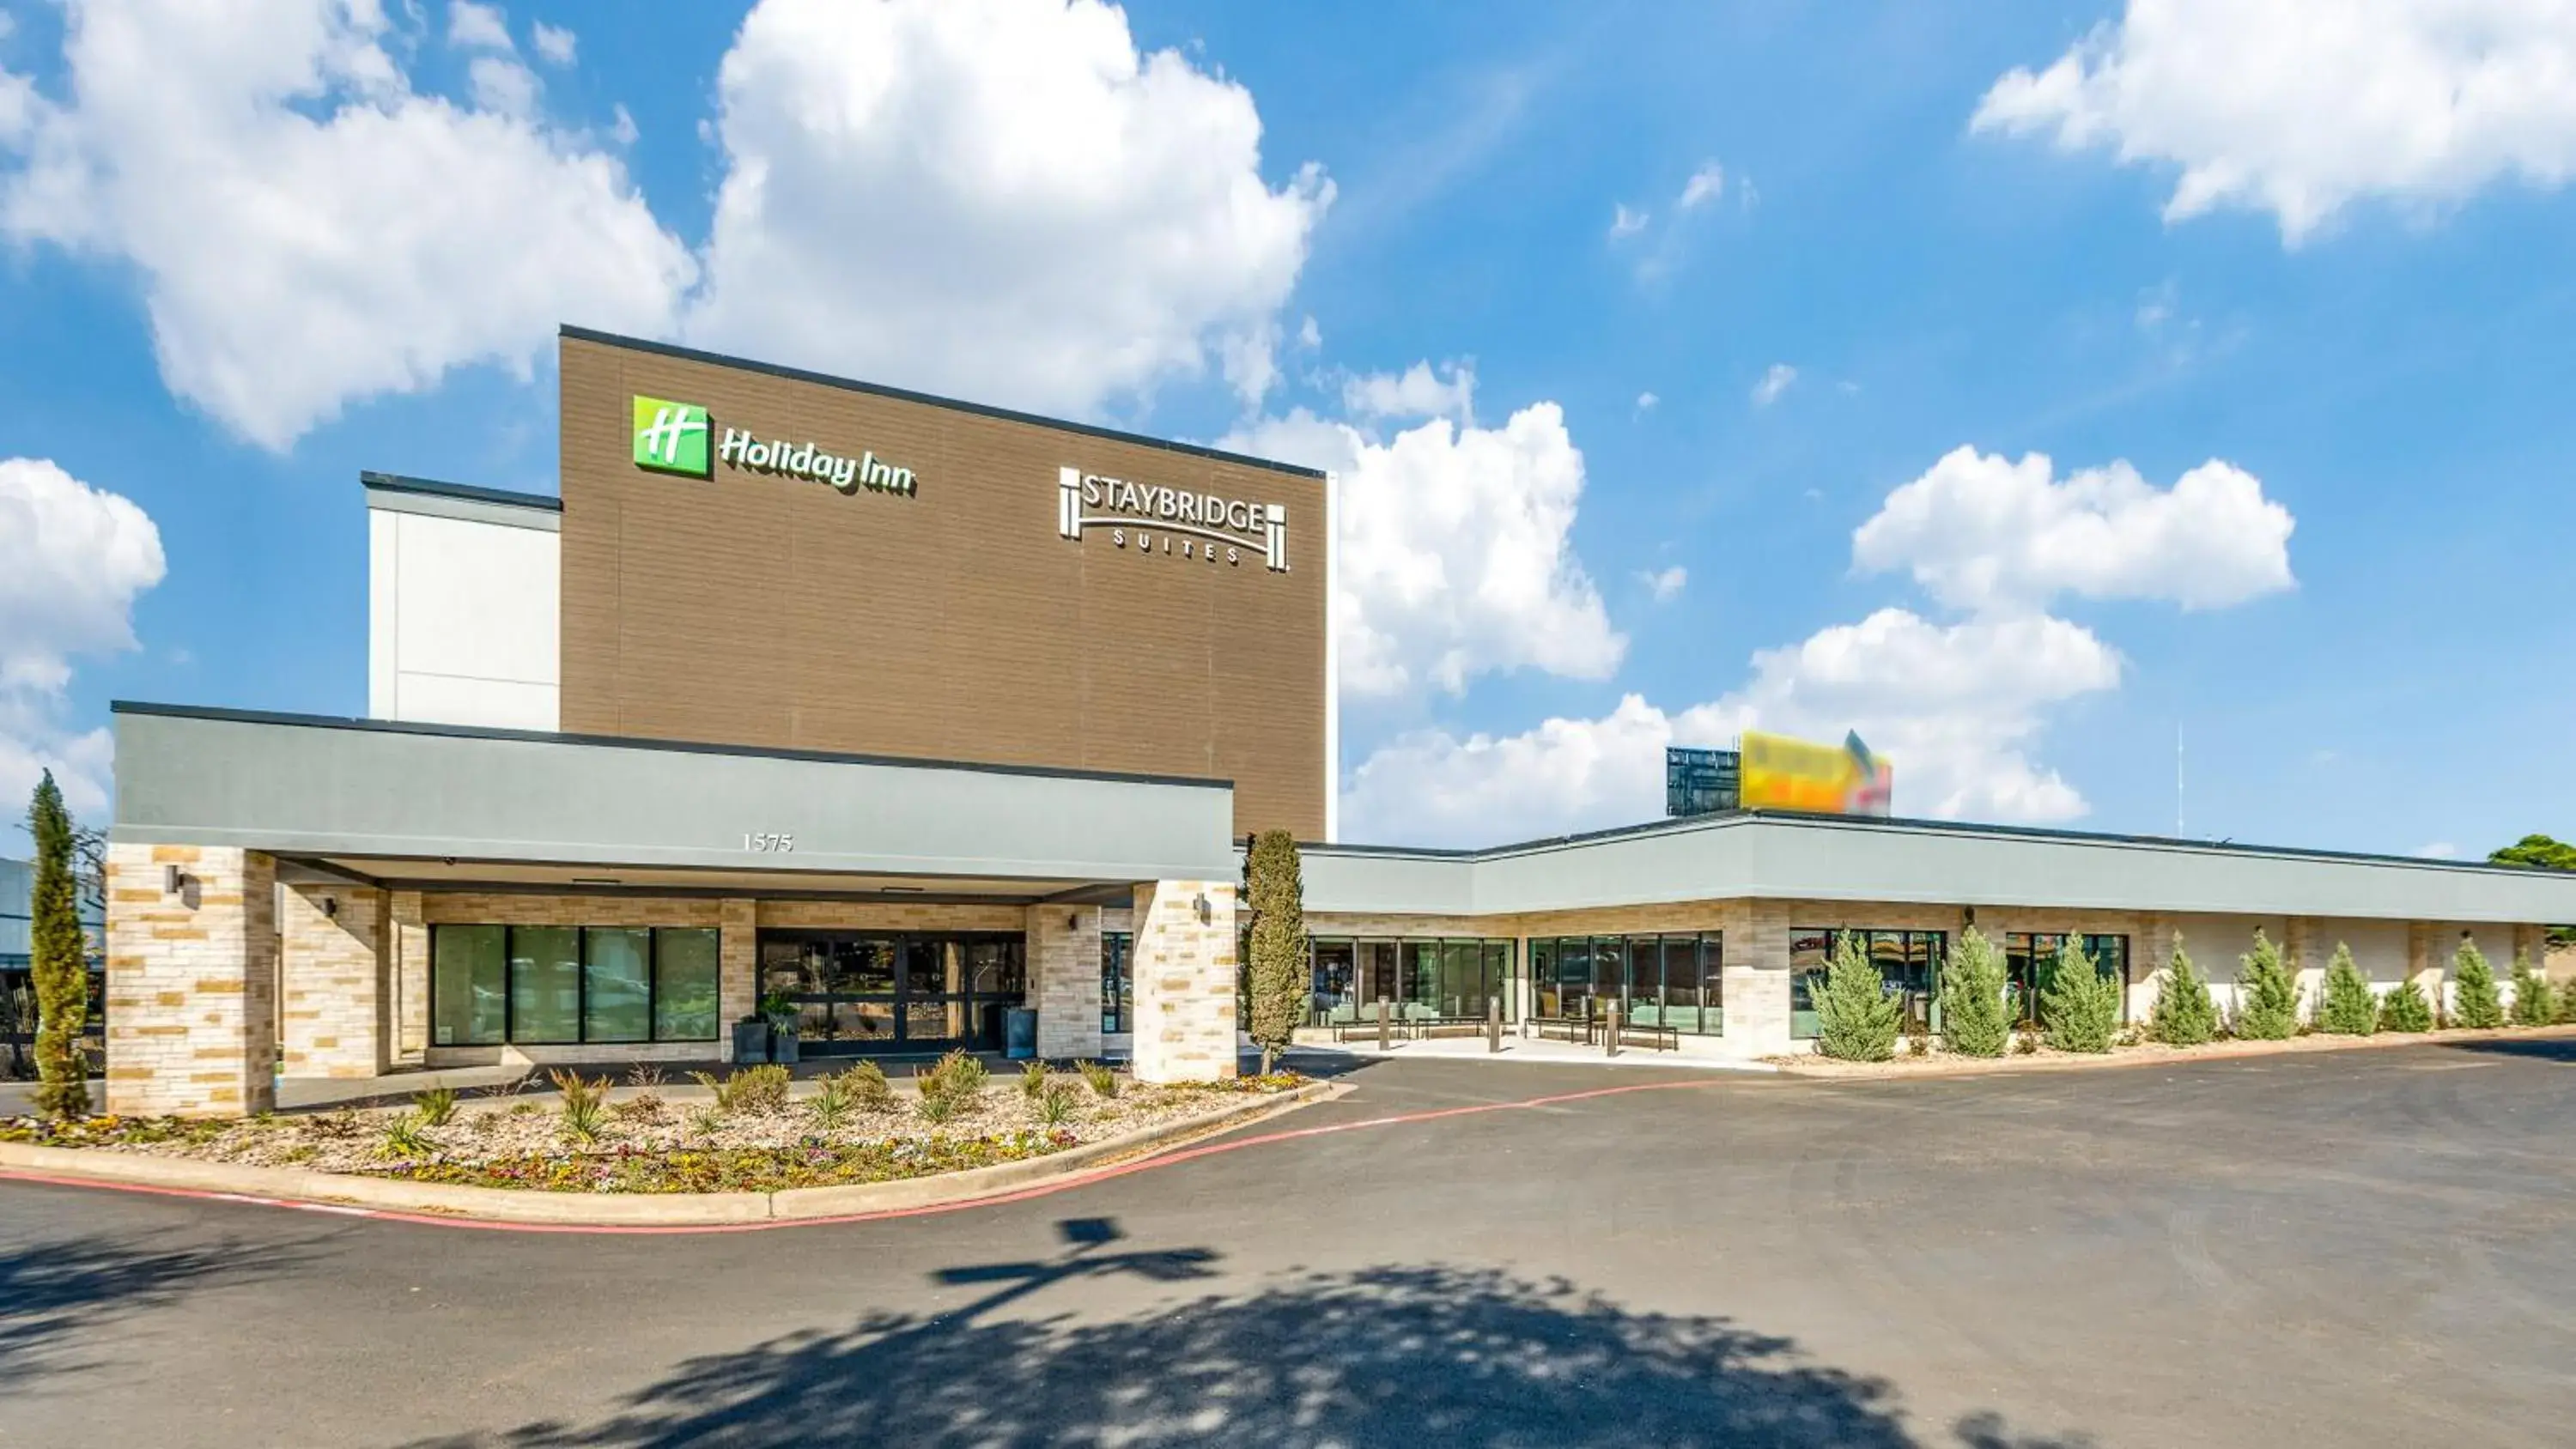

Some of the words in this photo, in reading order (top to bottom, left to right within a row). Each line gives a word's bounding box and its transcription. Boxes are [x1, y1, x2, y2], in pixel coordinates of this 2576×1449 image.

[720, 427, 856, 488] Holiday
[860, 452, 914, 490] Inn
[1084, 475, 1264, 531] STAYBRIDGE
[1113, 529, 1238, 562] SUITES
[744, 834, 793, 852] 1575
